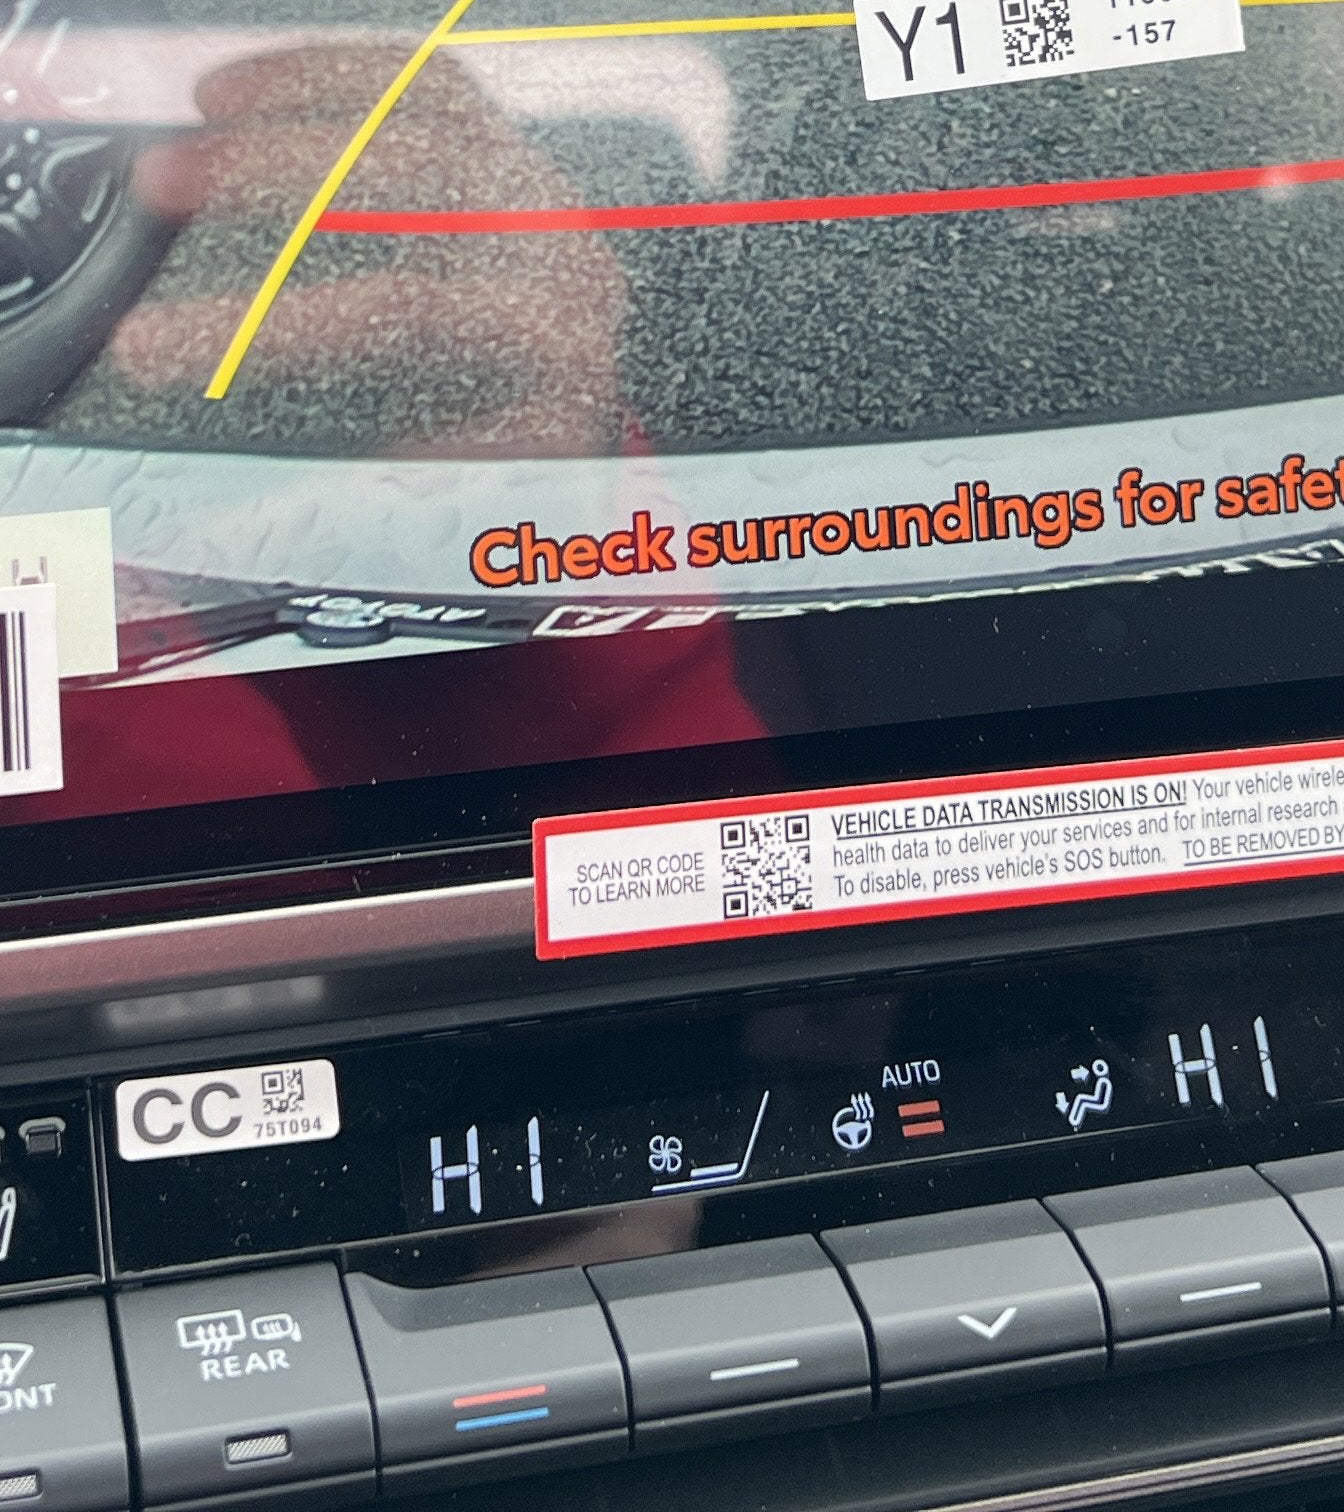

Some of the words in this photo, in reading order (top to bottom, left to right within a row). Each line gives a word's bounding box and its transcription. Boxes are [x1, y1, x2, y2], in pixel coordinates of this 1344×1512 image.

[874, 1, 966, 82] Y1
[1111, 19, 1177, 47] -157
[469, 510, 675, 588] Check
[687, 480, 1104, 566] surroundings
[1115, 466, 1204, 526] for
[831, 807, 916, 836] VEHICLE
[923, 801, 973, 827] DATA
[978, 784, 1124, 821] TRANSMISSION
[1131, 784, 1148, 805] IS
[1154, 779, 1187, 804] ON!
[1192, 778, 1231, 801] Your
[1235, 771, 1293, 796] vehicle
[833, 840, 885, 867] health
[892, 837, 929, 861] data
[936, 838, 952, 857] to
[958, 829, 1015, 854] deliver
[1020, 829, 1057, 853] your
[1063, 817, 1132, 844] services
[1138, 814, 1168, 835] and
[1174, 810, 1196, 831] for
[1201, 802, 1262, 829] internal
[1268, 795, 1338, 821] research
[577, 861, 623, 884] SCAN
[627, 857, 653, 879] QR
[656, 851, 705, 875] CODE
[834, 874, 854, 897] To
[860, 868, 926, 895] disable,
[933, 865, 980, 892] press
[985, 854, 1058, 880] vehicle's
[1064, 848, 1103, 873] SOS
[1109, 846, 1166, 868] button.
[1182, 839, 1205, 860] TO
[1211, 836, 1232, 857] BE
[1237, 826, 1320, 853] REMOVED
[568, 885, 592, 907] TO
[594, 878, 652, 904] LEARN
[656, 872, 705, 897] MORE
[881, 1059, 941, 1088] AUTO
[132, 1082, 243, 1144] CC
[254, 1115, 322, 1139] 75T094
[201, 1346, 291, 1381] REAR
